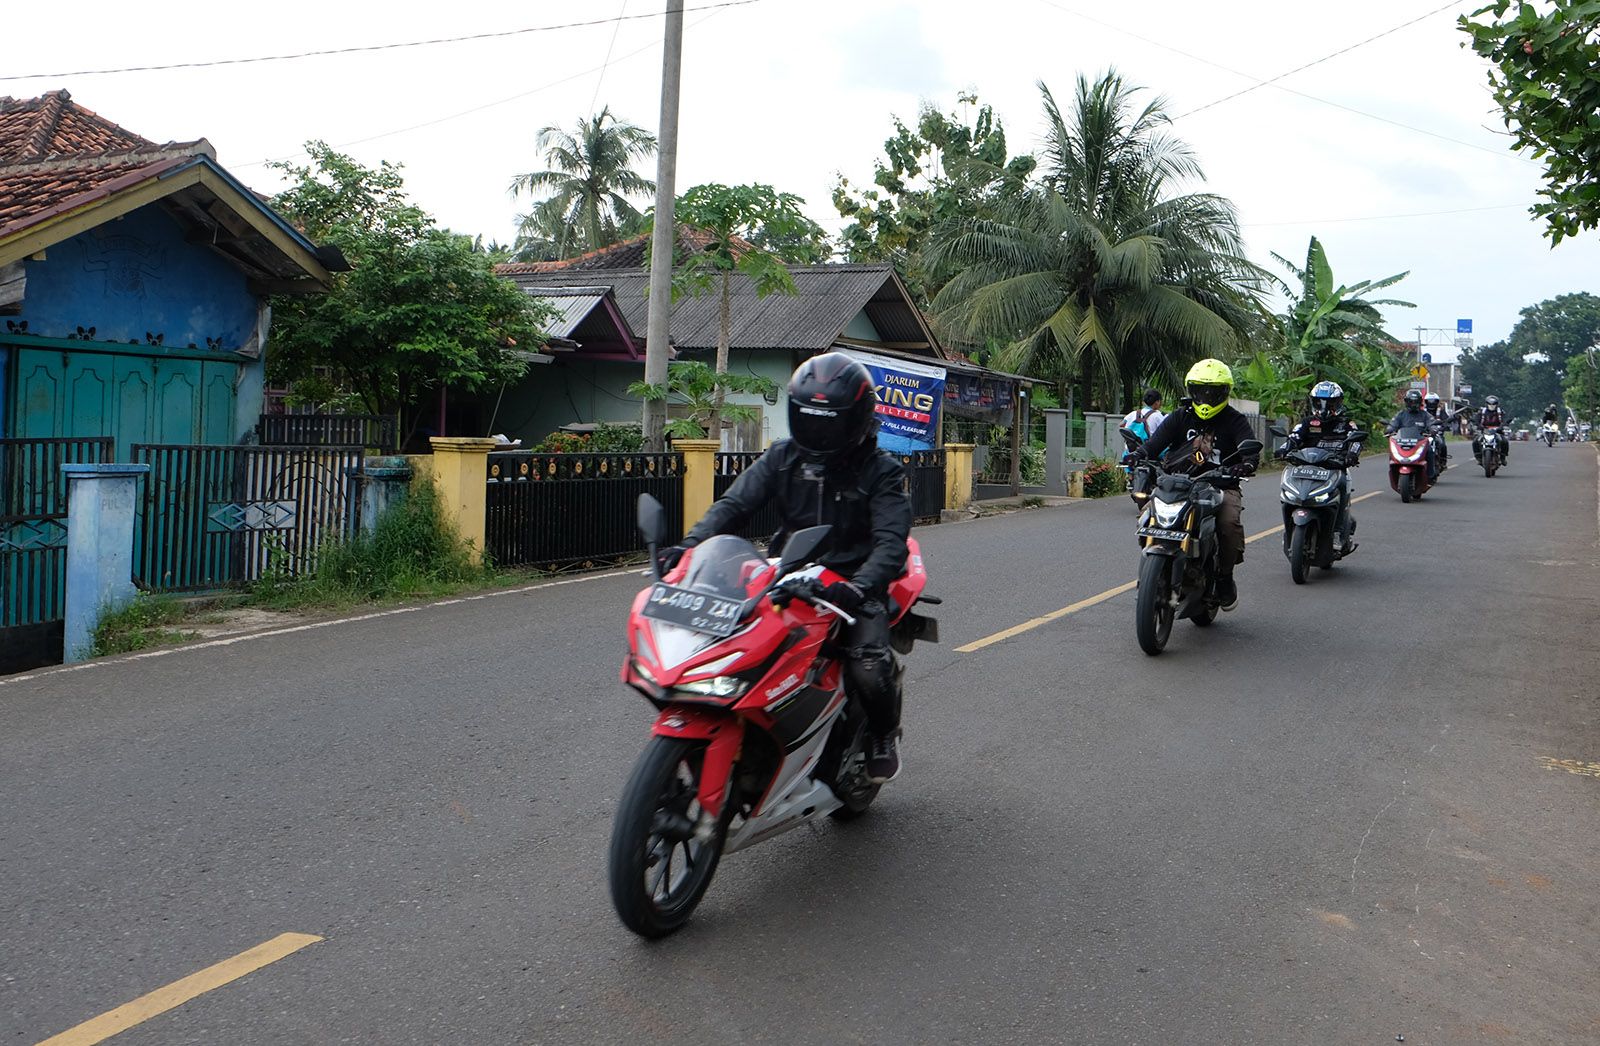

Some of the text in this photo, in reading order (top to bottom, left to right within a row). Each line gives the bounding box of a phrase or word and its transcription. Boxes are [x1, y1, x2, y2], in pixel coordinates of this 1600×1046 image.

[885, 374, 920, 388] DJARUM
[868, 385, 934, 412] KING
[874, 405, 919, 420] FILTER
[886, 422, 900, 430] FULL
[900, 424, 928, 436] PLEASURE
[650, 587, 740, 619] D 4109 ZXX
